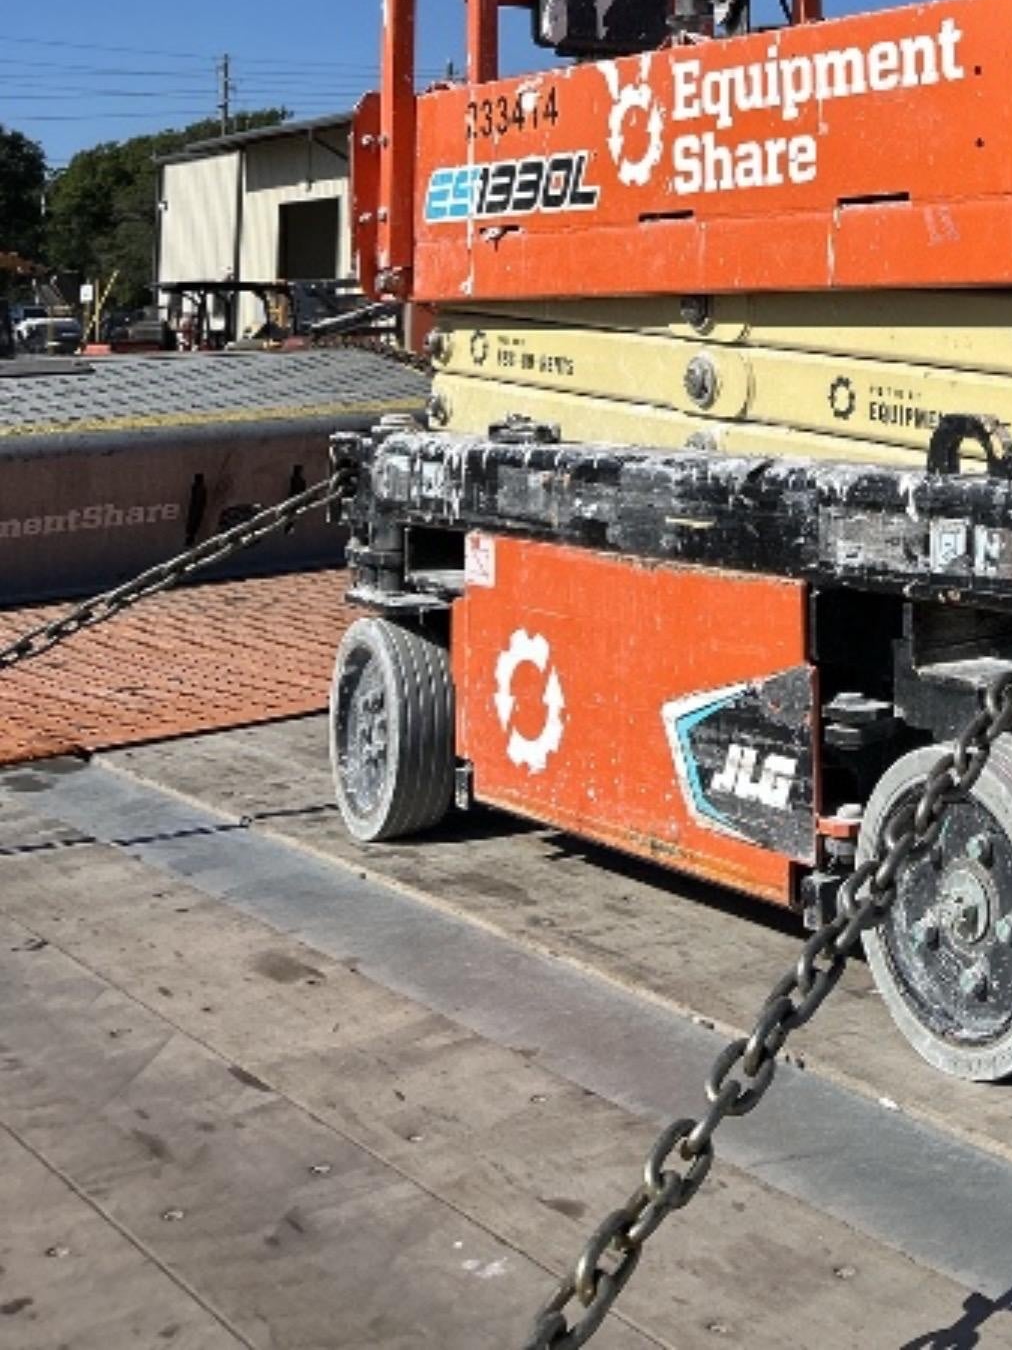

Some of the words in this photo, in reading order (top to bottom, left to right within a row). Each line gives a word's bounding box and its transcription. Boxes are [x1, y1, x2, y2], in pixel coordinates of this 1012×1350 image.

[671, 17, 964, 129] Equipment
[671, 131, 818, 195] Share
[710, 743, 798, 810] JLG
